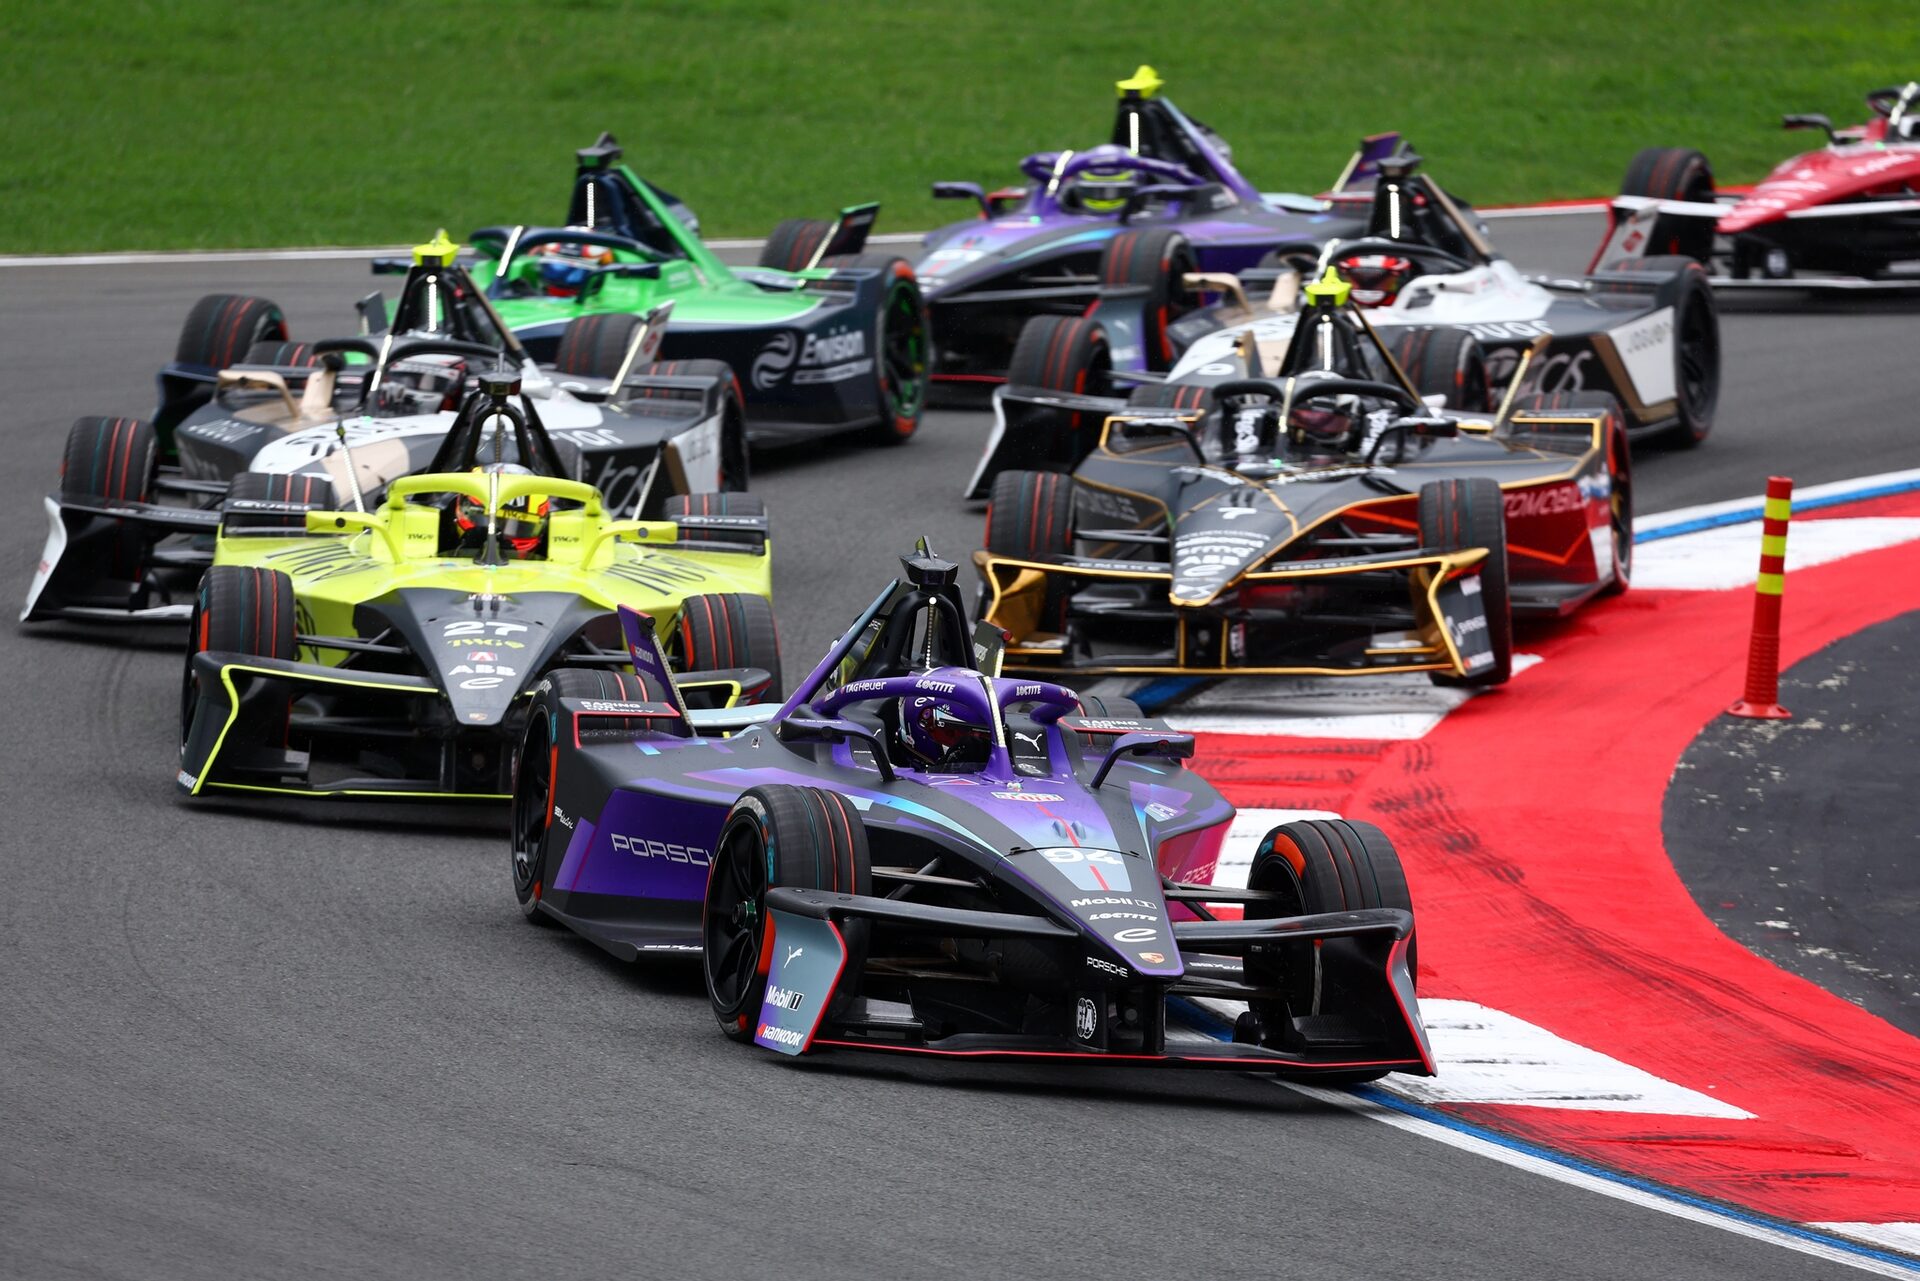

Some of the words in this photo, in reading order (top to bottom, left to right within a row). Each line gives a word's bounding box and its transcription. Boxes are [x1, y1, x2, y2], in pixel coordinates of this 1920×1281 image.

[443, 621, 528, 637] 27
[448, 664, 517, 676] ABB
[915, 679, 957, 694] LOCTITE
[1016, 684, 1042, 697] LOCTITE
[1044, 847, 1123, 865] 94
[1070, 896, 1133, 908] Mobil
[1088, 912, 1158, 922] LOCTITE
[1086, 956, 1129, 978] PORSCHE
[766, 985, 794, 1009] Mobil
